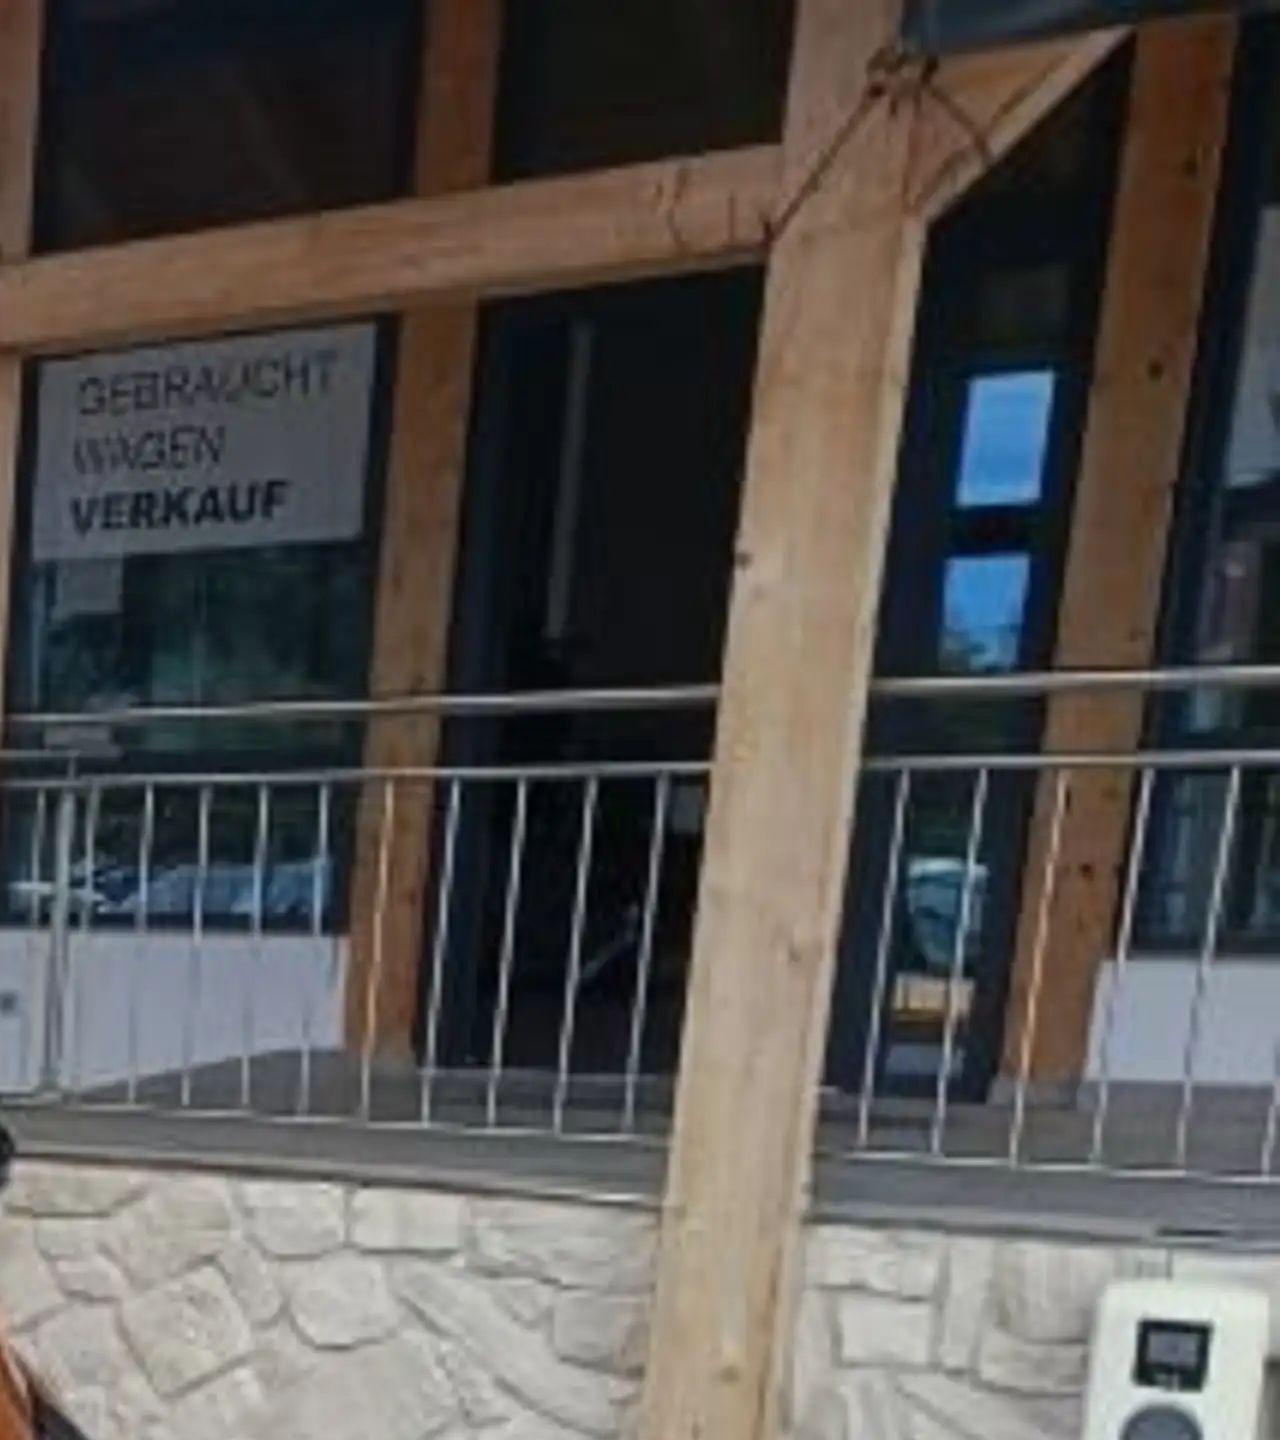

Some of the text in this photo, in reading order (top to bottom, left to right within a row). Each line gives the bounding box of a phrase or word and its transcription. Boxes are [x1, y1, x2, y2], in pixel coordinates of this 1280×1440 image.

[77, 350, 339, 417] GEBRAUCHT
[72, 424, 226, 475] WAGEN
[69, 478, 292, 537] VERKAUF
